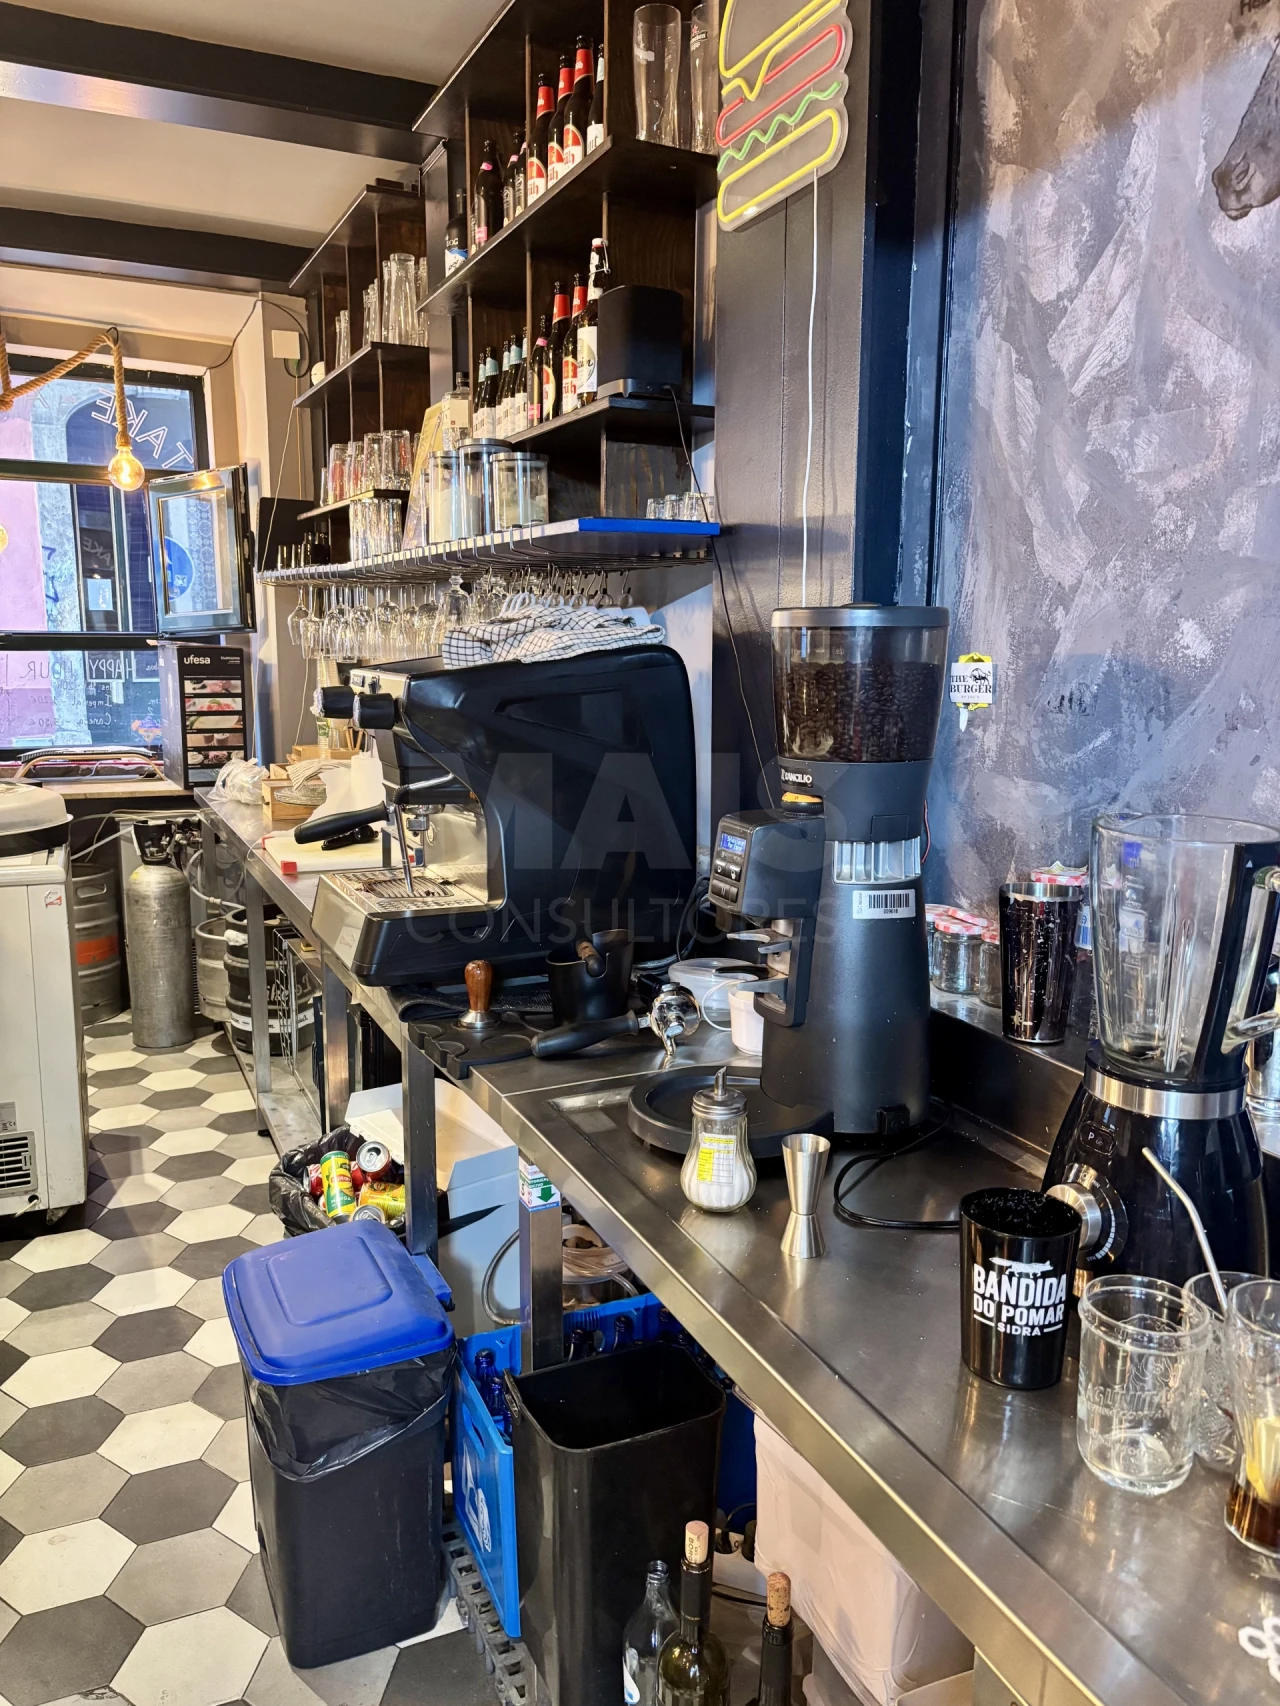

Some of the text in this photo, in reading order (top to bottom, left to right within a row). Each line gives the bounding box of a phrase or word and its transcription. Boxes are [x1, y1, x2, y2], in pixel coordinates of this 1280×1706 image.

[184, 654, 211, 665] ufesa
[950, 675, 969, 683] THE
[950, 684, 992, 694] BURGER
[1088, 1131, 1095, 1141] P
[974, 1263, 1066, 1307] BANDIDA
[973, 1293, 1064, 1326] DO POMAR
[997, 1322, 1041, 1336] SIDRA
